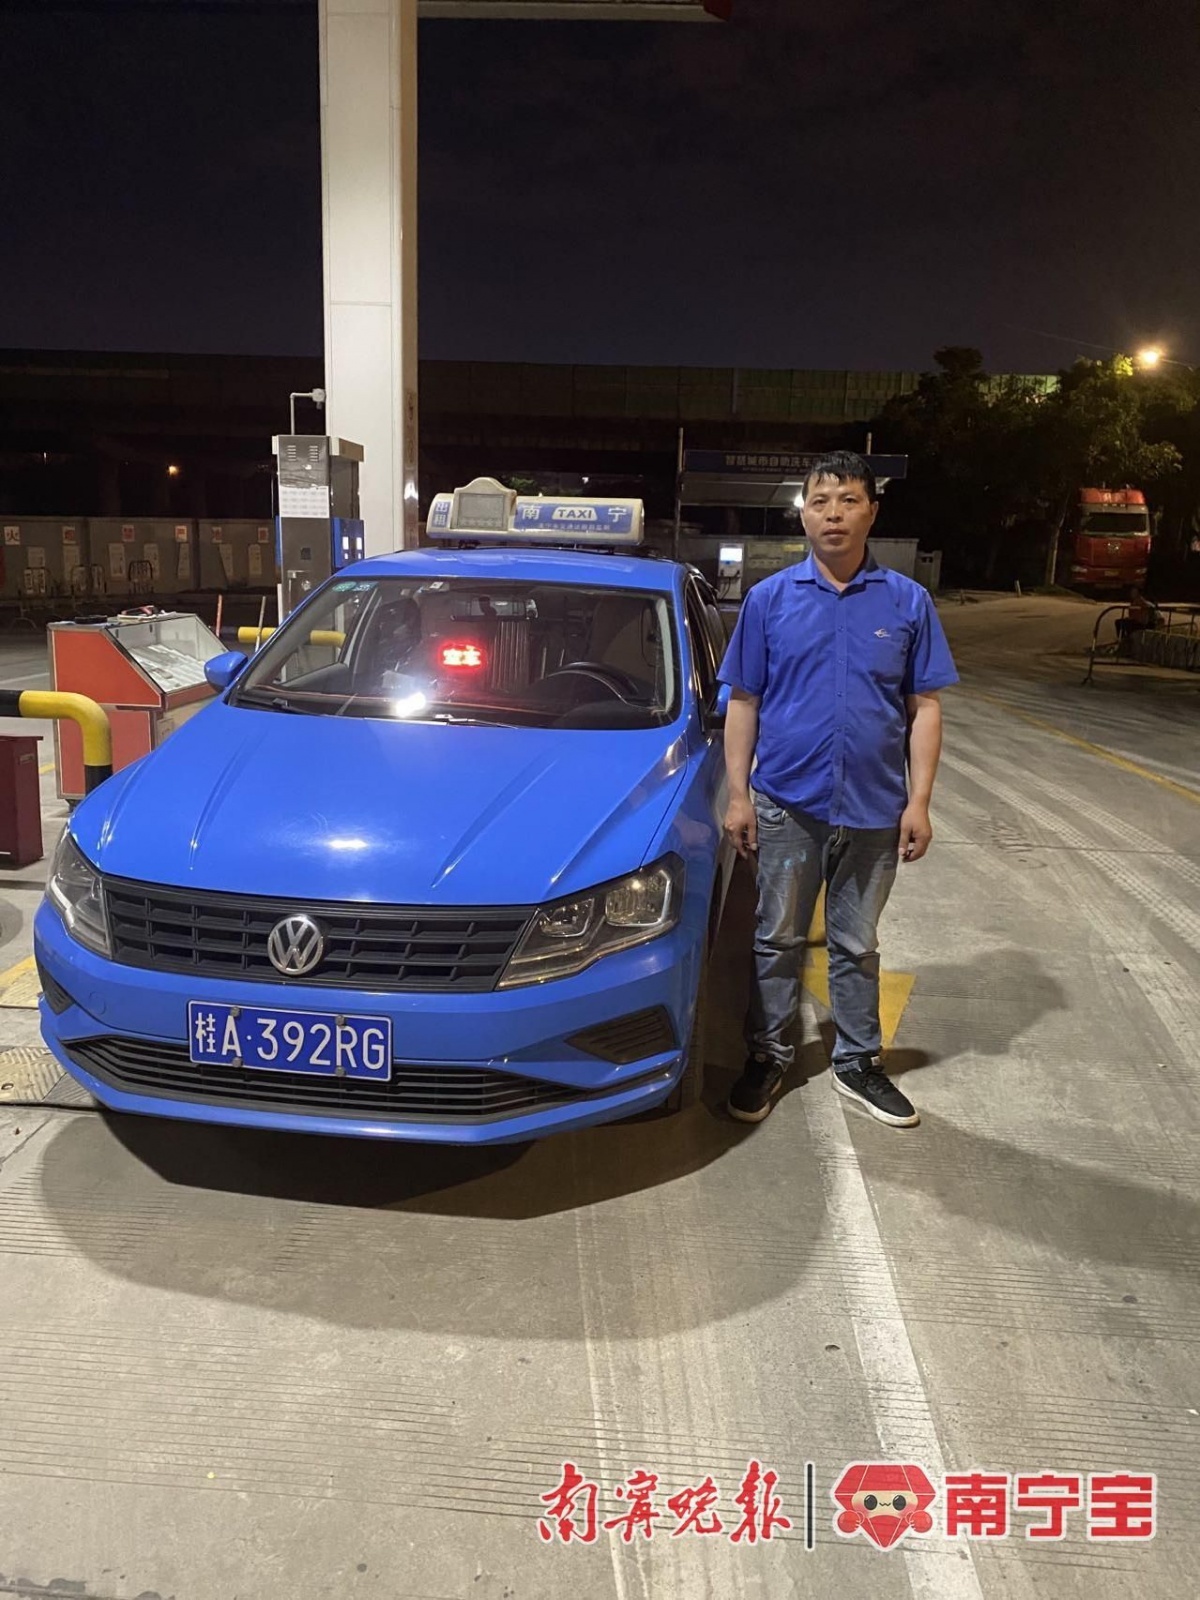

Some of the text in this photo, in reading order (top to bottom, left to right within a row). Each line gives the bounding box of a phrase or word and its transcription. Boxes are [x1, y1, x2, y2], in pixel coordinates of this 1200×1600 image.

[521, 504, 627, 523] 南 TAXI 宁
